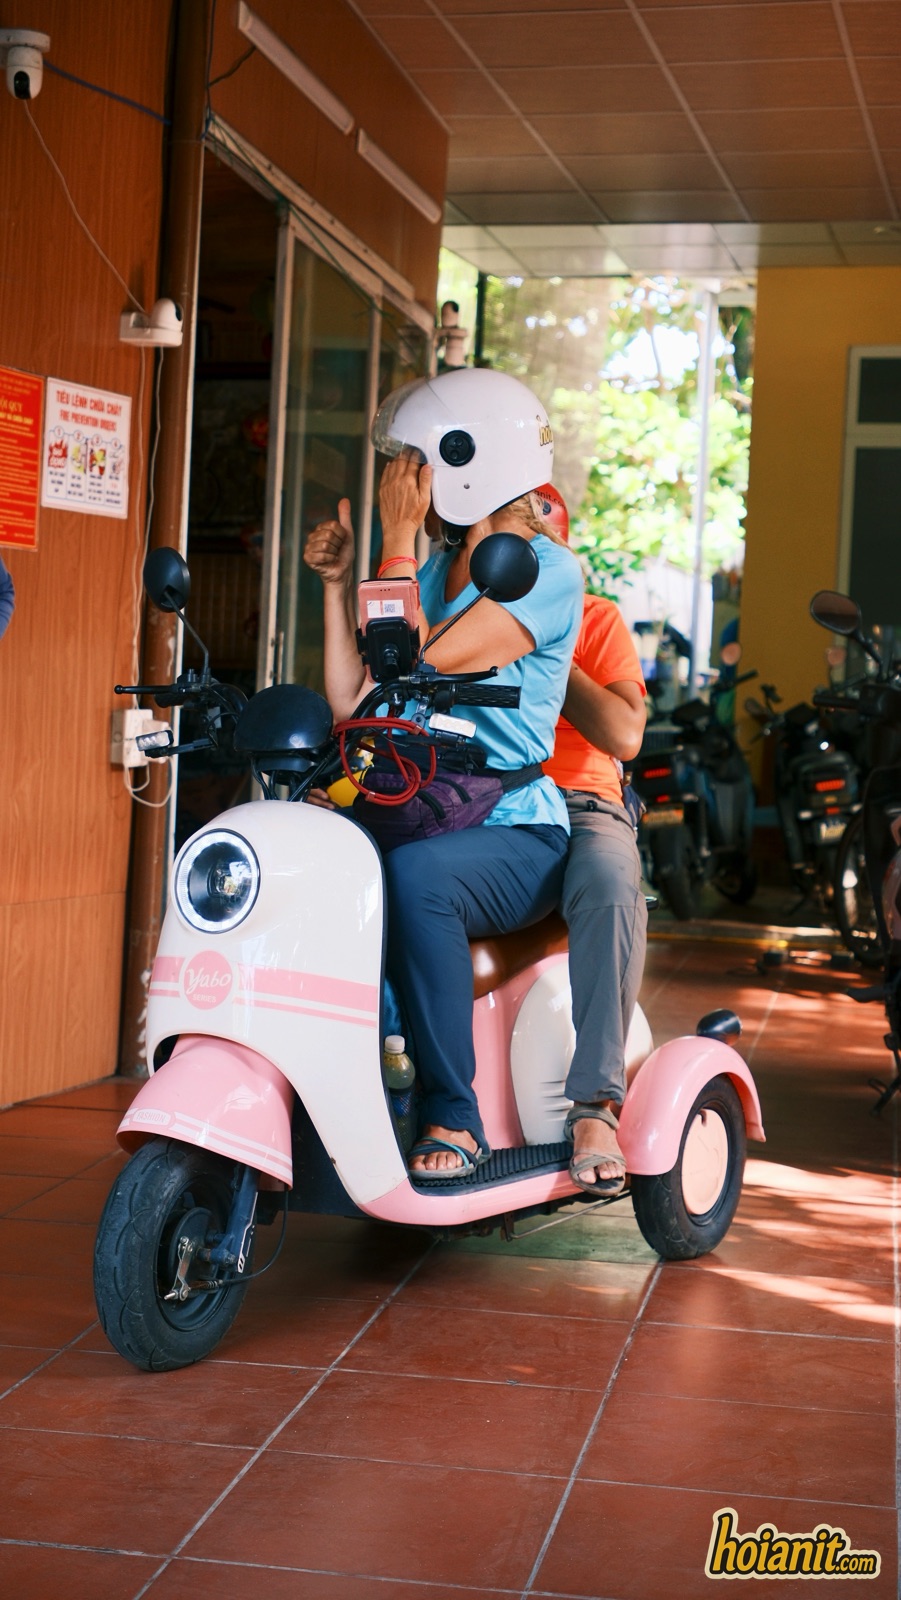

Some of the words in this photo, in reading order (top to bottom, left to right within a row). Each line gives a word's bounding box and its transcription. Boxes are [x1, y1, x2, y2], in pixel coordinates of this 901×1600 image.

[186, 967, 232, 995] Yabo
[192, 993, 217, 1004] SERIES
[136, 1111, 167, 1123] FASHION
